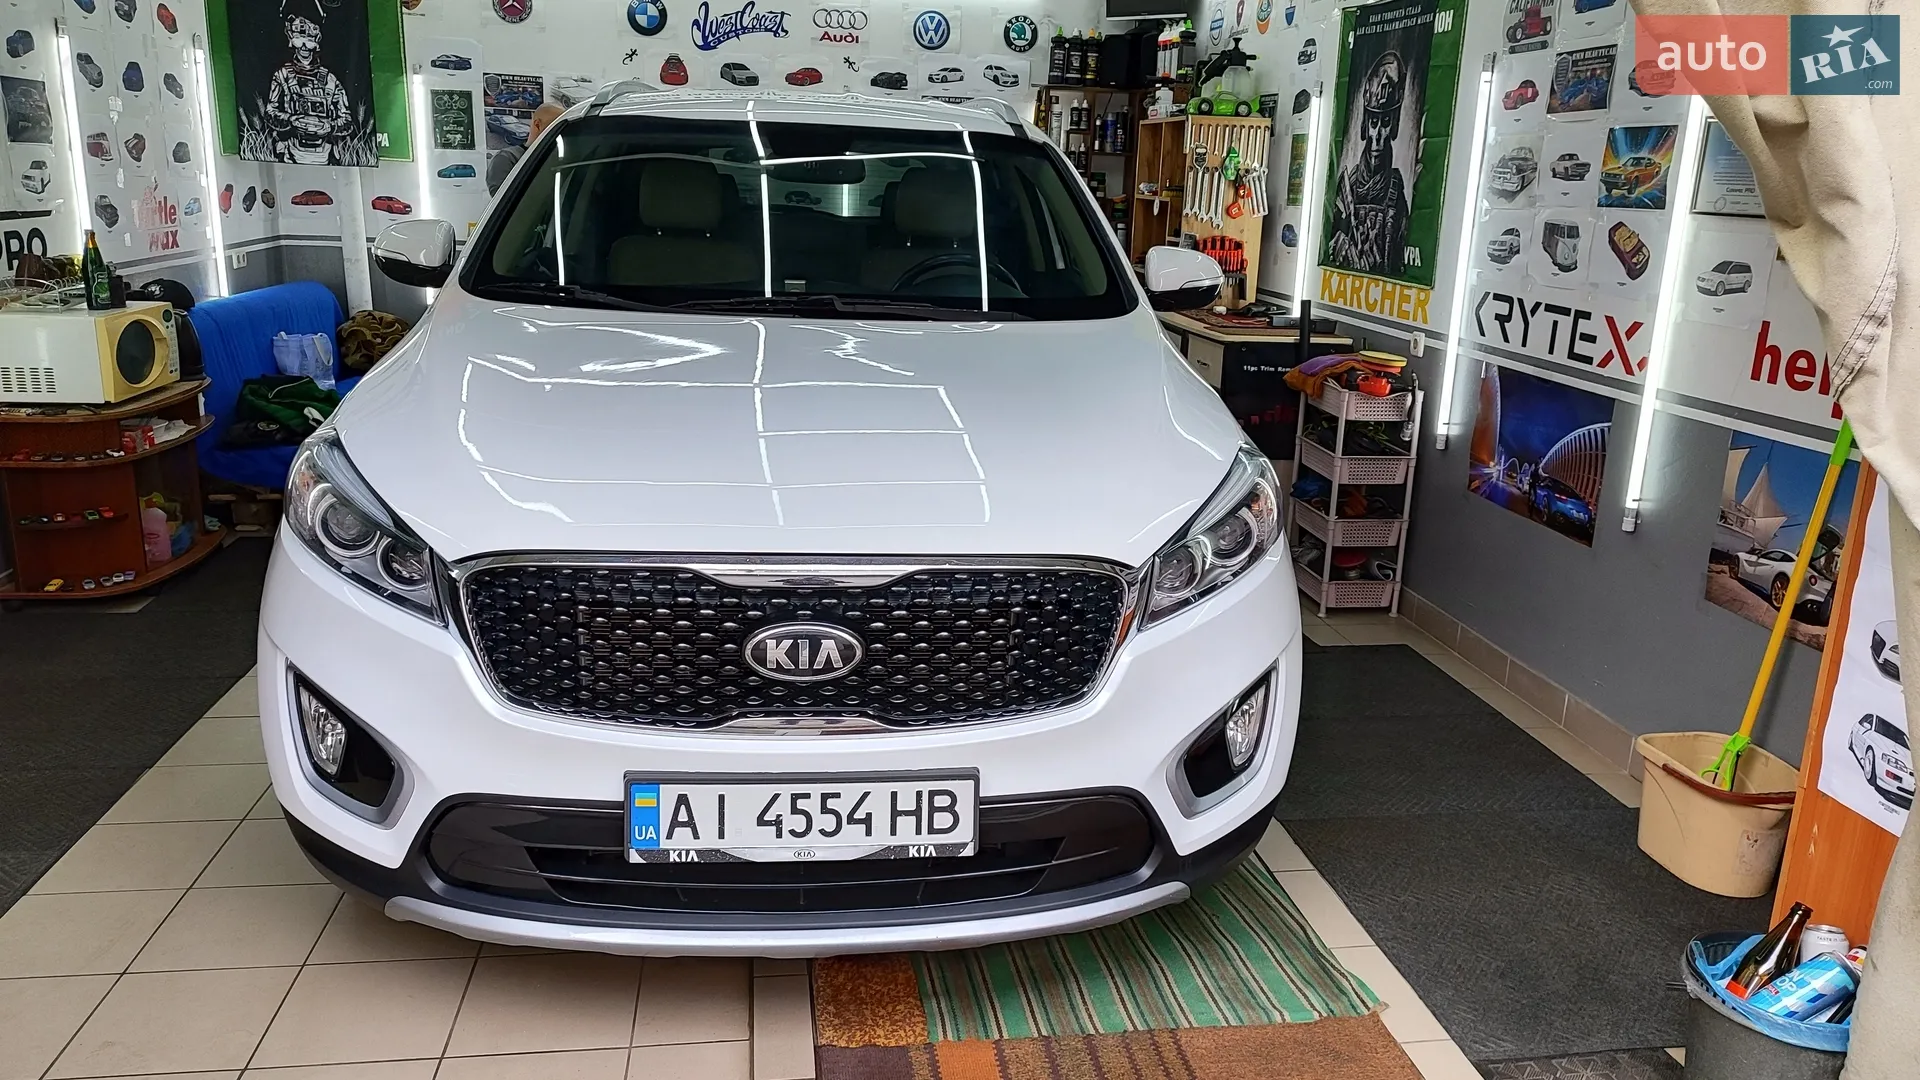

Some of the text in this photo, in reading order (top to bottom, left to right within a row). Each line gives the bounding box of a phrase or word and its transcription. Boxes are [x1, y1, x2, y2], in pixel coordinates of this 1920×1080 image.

[819, 31, 859, 44] Audi
[765, 639, 843, 669] KIA
[757, 791, 873, 839] 4554
[890, 789, 961, 837] HB
[634, 825, 657, 841] UA
[669, 850, 699, 862] KIA
[908, 845, 937, 858] KIA
